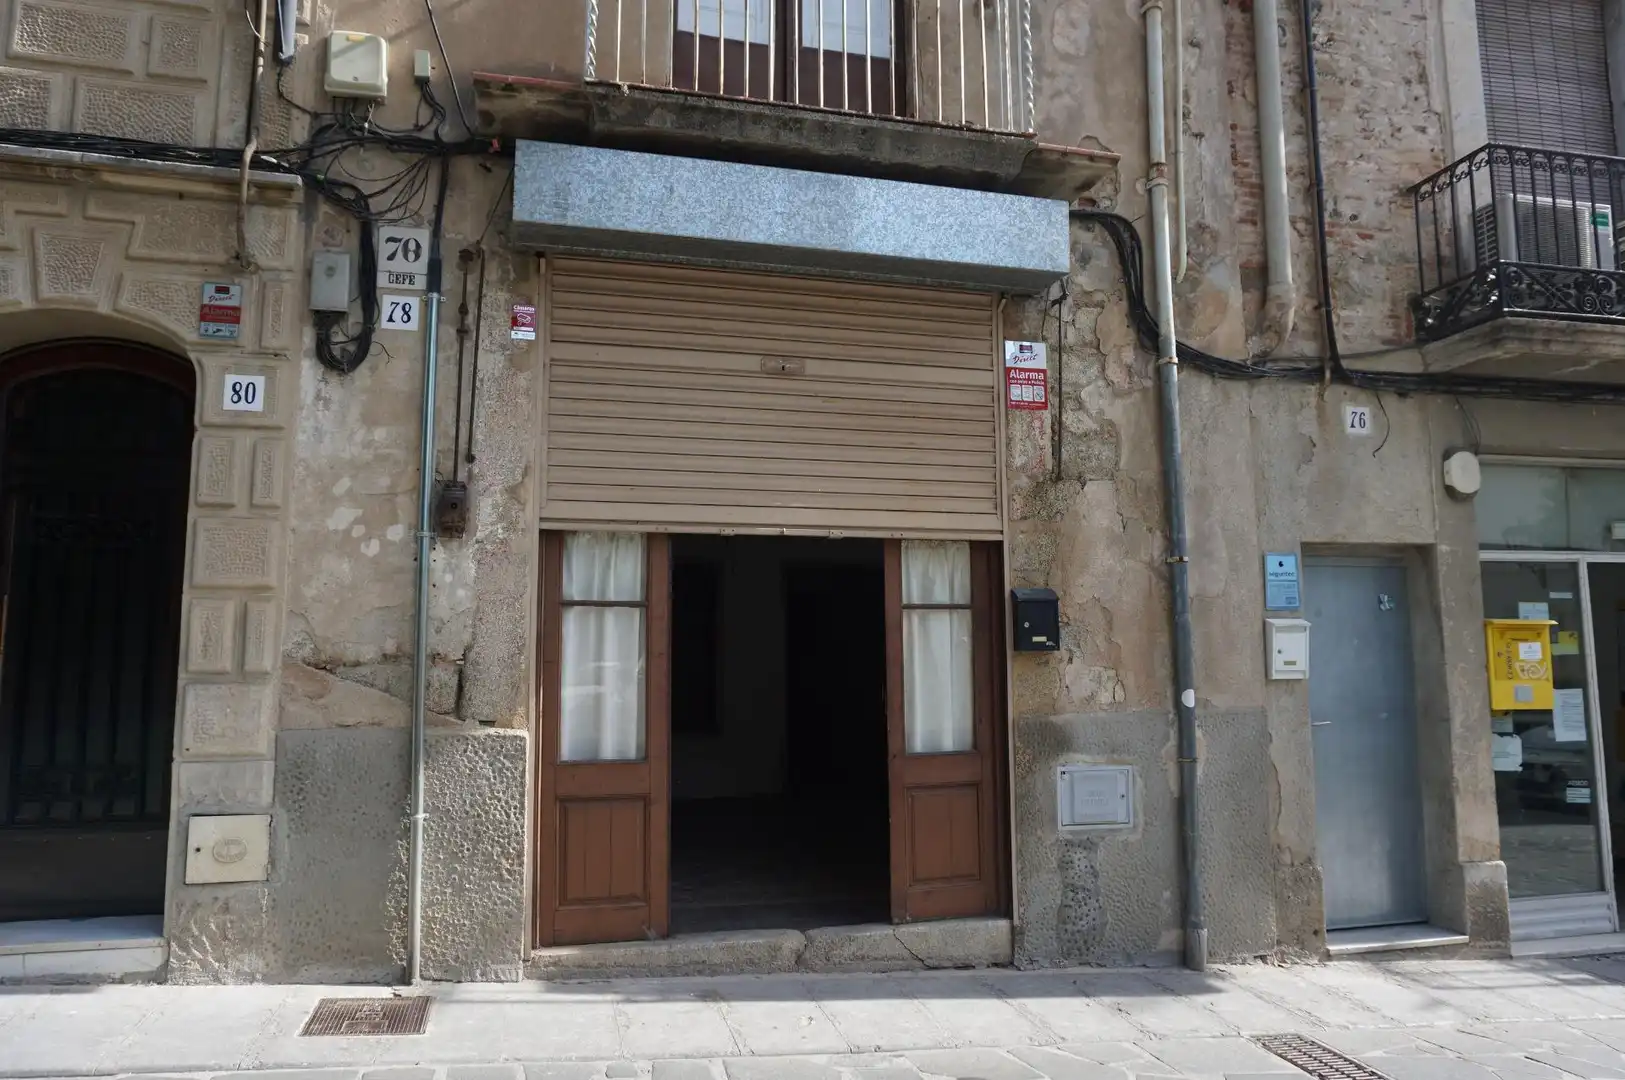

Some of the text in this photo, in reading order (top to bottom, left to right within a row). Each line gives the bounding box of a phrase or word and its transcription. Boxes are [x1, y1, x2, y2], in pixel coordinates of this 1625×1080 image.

[386, 301, 412, 324] 78
[1010, 369, 1044, 380] Alarma
[231, 381, 257, 405] 80
[1350, 411, 1366, 429] 76
